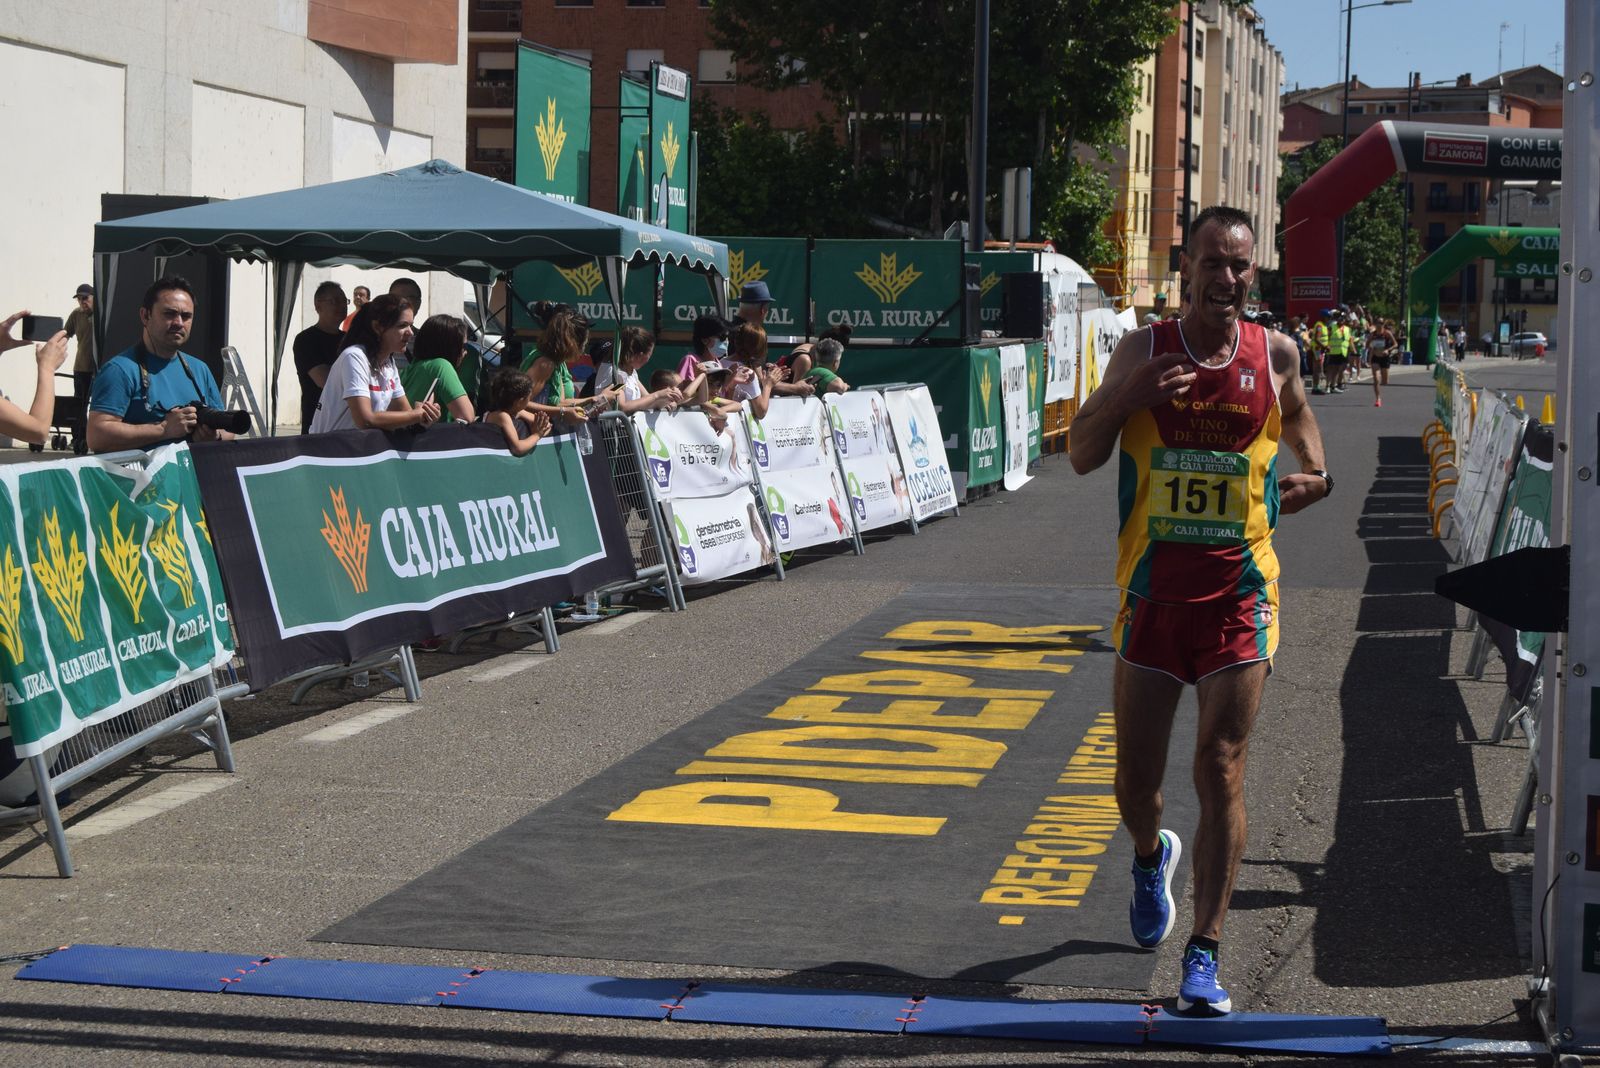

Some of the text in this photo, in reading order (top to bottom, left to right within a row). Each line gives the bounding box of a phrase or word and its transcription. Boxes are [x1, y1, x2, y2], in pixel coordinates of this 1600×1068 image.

[1501, 137, 1554, 151] CON EL
[1439, 150, 1483, 160] ZAMORA
[827, 309, 950, 327] CAJA RURAL
[1192, 401, 1250, 414] CAJA RURAL
[1190, 418, 1228, 431] VINO
[1175, 431, 1240, 445] DE TORO
[1180, 463, 1237, 473] CAJA RURAL
[1165, 476, 1228, 516] 151
[380, 490, 561, 579] CAJA RURAL
[1174, 525, 1239, 538] CAJA RURAL
[59, 648, 112, 685] CAJA RURAL
[979, 794, 1122, 907] REFORMA
